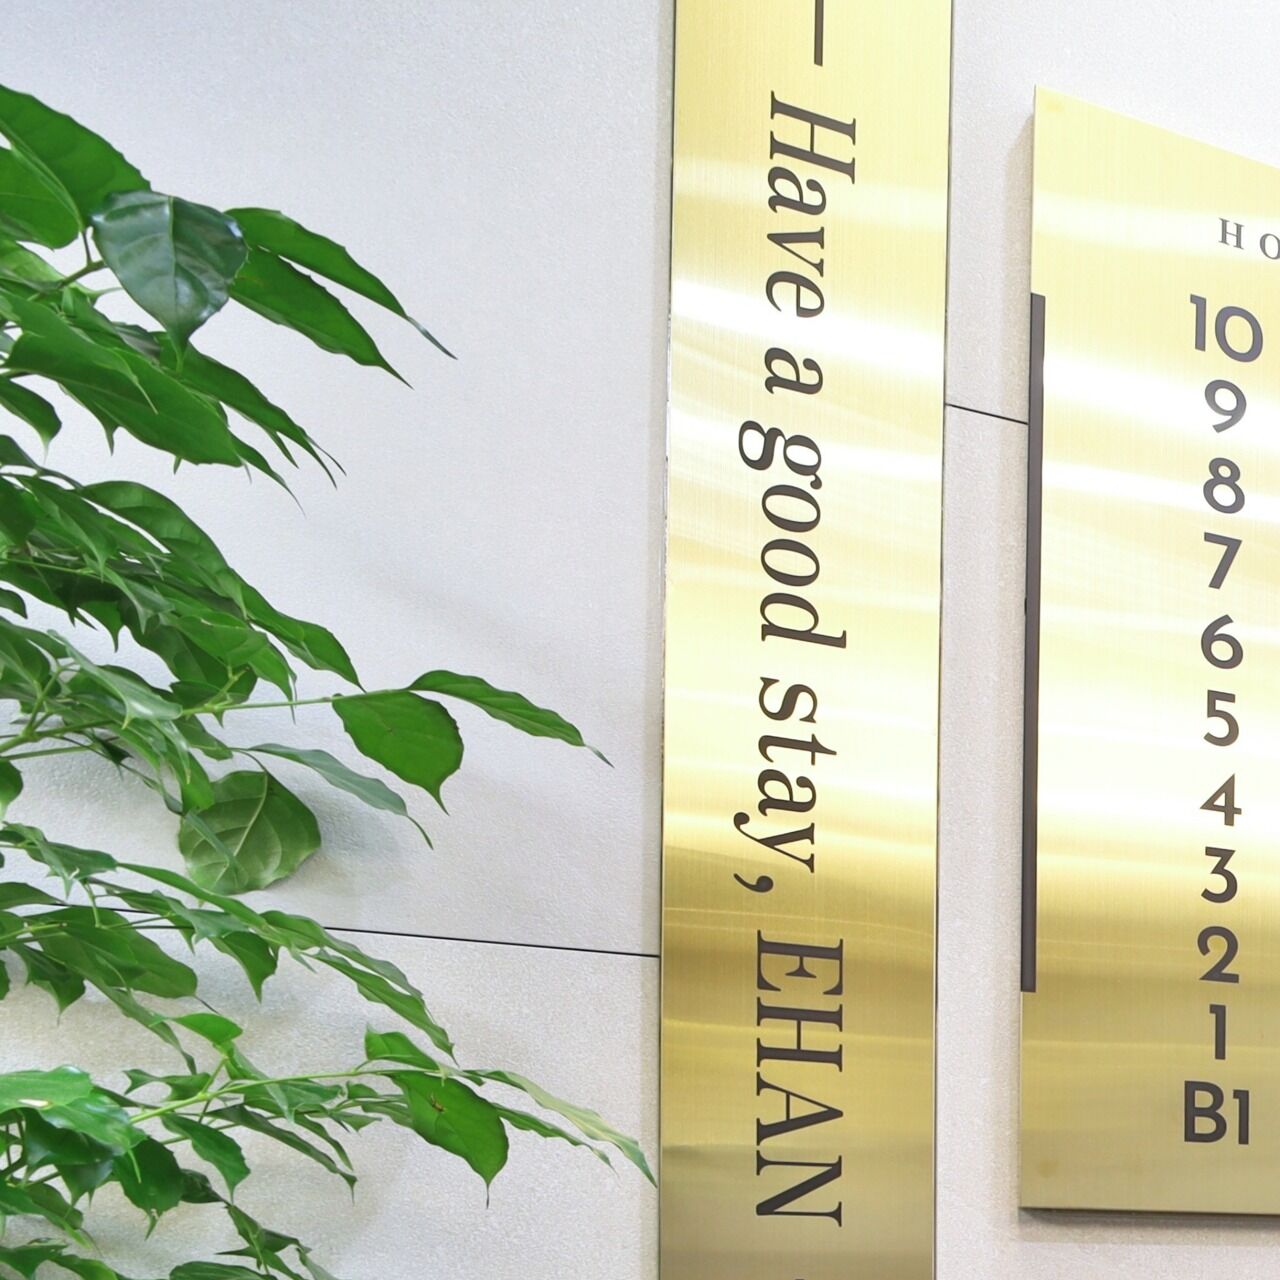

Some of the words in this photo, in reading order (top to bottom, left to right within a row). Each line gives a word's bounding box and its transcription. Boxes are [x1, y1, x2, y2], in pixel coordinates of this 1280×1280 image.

[764, 90, 856, 318] Have
[1189, 293, 1265, 363] 10
[763, 346, 824, 395] a
[1202, 378, 1248, 434] 9
[1202, 458, 1246, 515] 8
[738, 419, 848, 649] good
[1202, 531, 1242, 590] 7
[1200, 614, 1244, 670] 6
[1202, 690, 1241, 747] 5
[732, 675, 838, 893] stay,
[1200, 773, 1242, 827] 4
[1200, 845, 1239, 904] 3
[1197, 925, 1240, 984] 2
[1208, 1003, 1227, 1060] 1
[755, 928, 844, 1228] EHAN
[1183, 1080, 1251, 1145] B1
